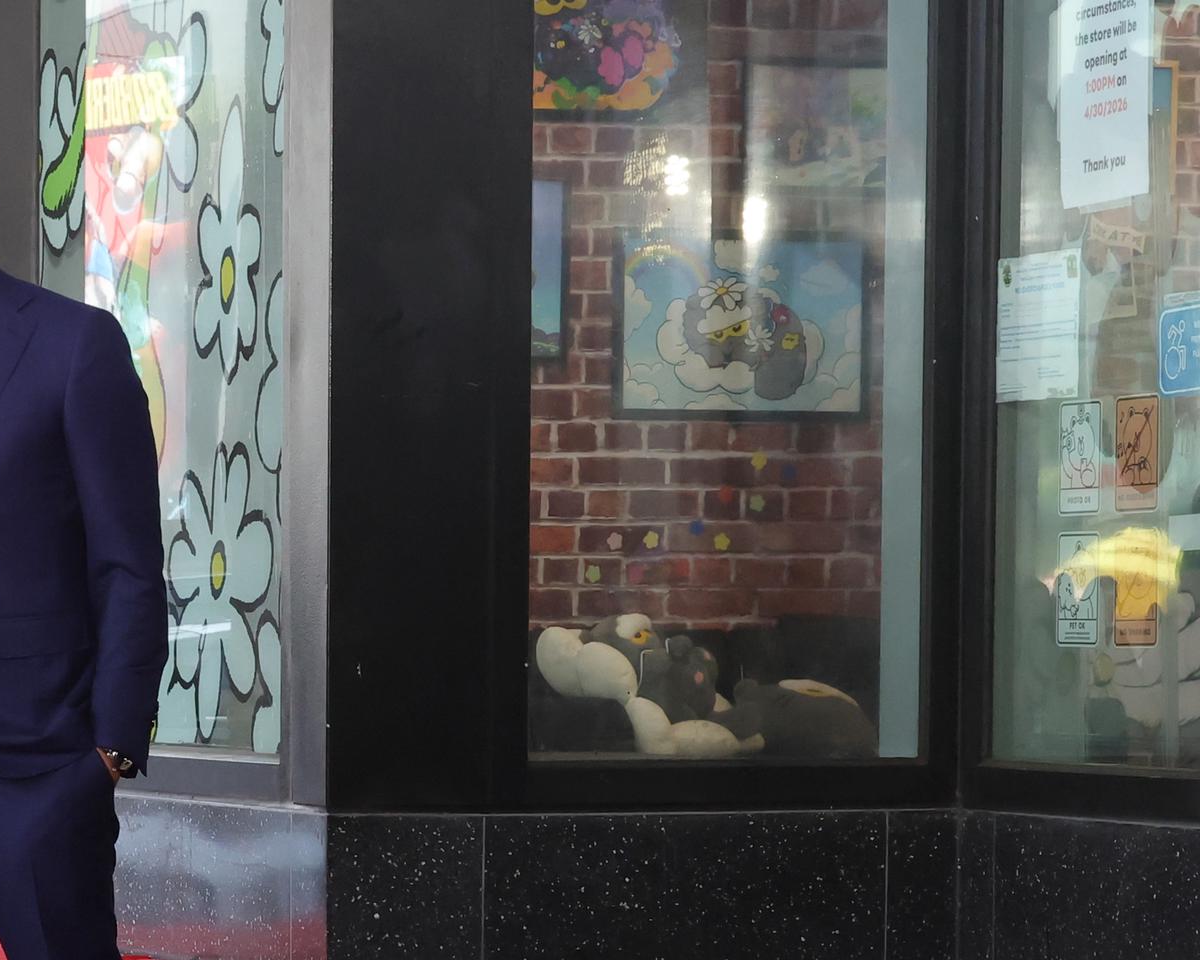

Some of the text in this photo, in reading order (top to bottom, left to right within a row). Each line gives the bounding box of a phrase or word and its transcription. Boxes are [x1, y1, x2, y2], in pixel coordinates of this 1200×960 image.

[1075, 20, 1137, 46] the store will be
[1084, 47, 1127, 72] opening at
[1086, 75, 1127, 94] 1:00PM on
[1084, 97, 1128, 119] 4/30/2026
[1083, 154, 1126, 174] Thank you
